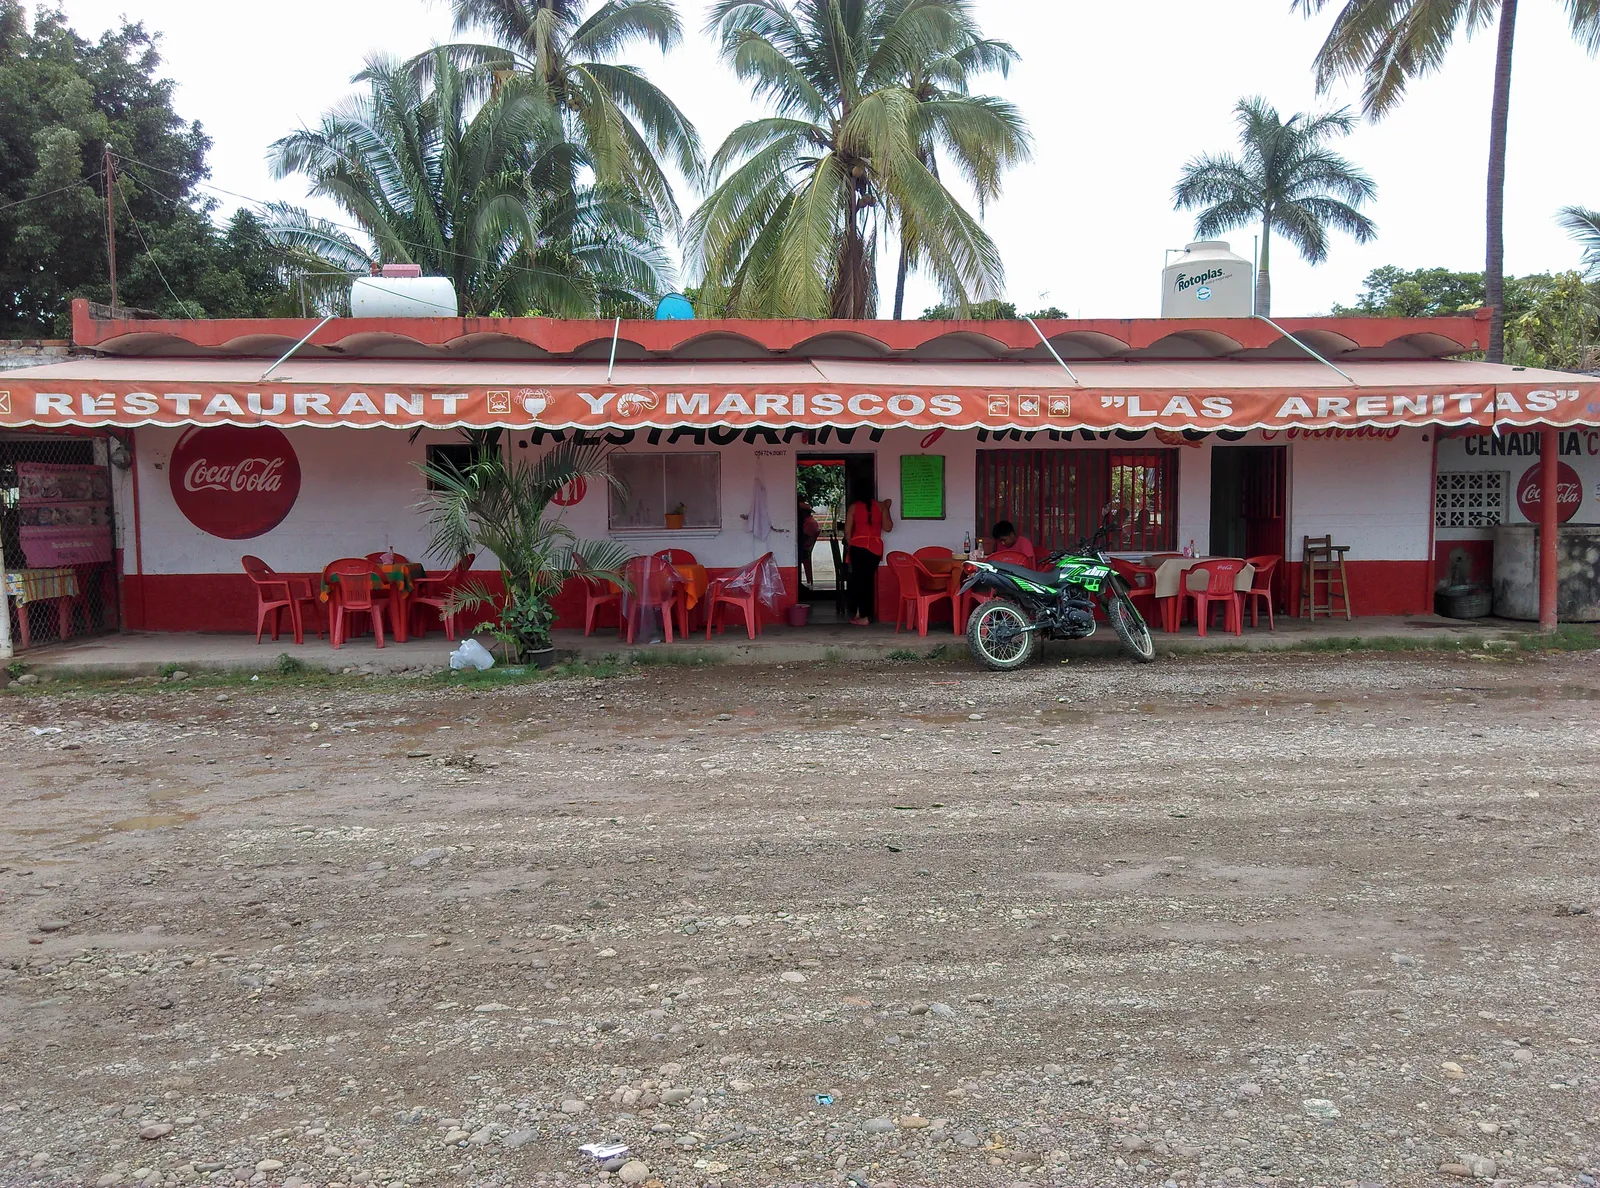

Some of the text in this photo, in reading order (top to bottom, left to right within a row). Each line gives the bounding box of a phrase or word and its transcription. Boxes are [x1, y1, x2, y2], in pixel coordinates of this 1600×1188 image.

[1178, 268, 1223, 292] Rotoplas
[35, 392, 468, 416] RESTAURANT
[577, 392, 617, 415] Y
[666, 393, 963, 416] MARISCOS
[1465, 432, 1581, 456] CENADUIA
[184, 457, 285, 492] Coca-Cola
